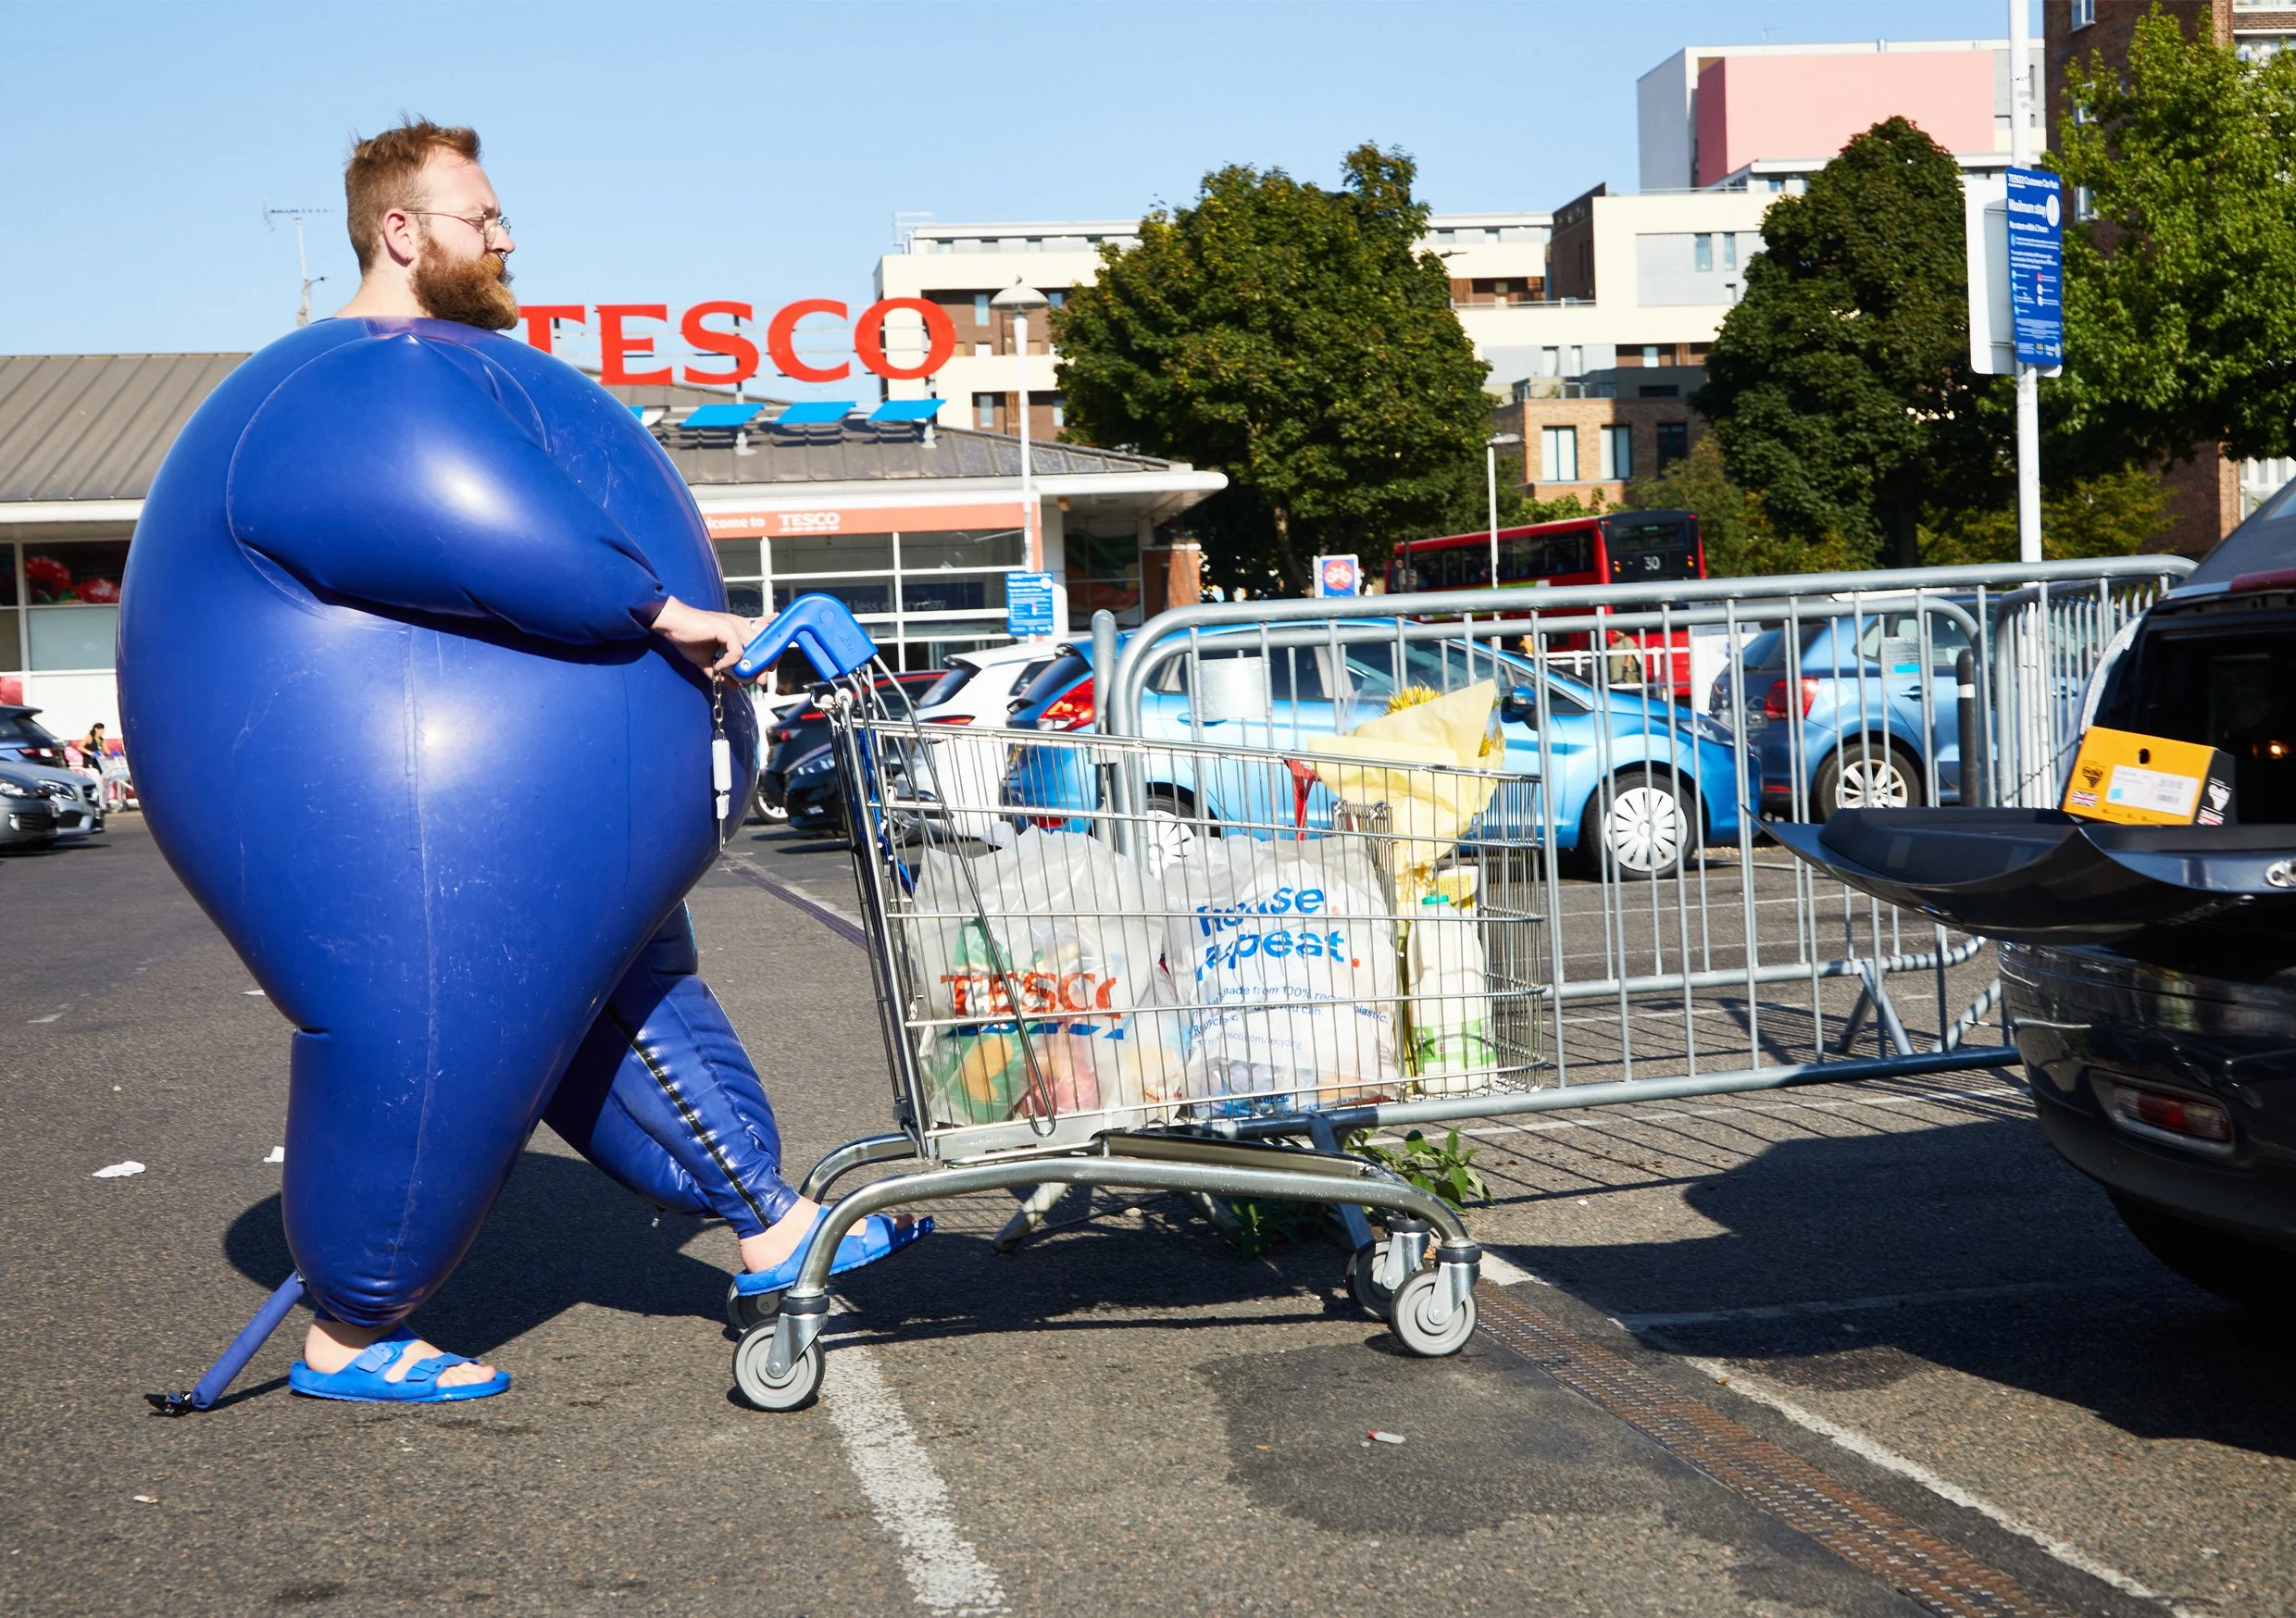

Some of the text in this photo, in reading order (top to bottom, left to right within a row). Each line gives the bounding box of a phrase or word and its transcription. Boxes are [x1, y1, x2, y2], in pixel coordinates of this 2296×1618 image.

[518, 297, 956, 386] TESCO
[750, 517, 766, 528] to
[778, 512, 842, 527] TESCO
[1643, 555, 1661, 570] 30
[1252, 985, 1279, 997] from
[1282, 985, 1311, 1001] 100%
